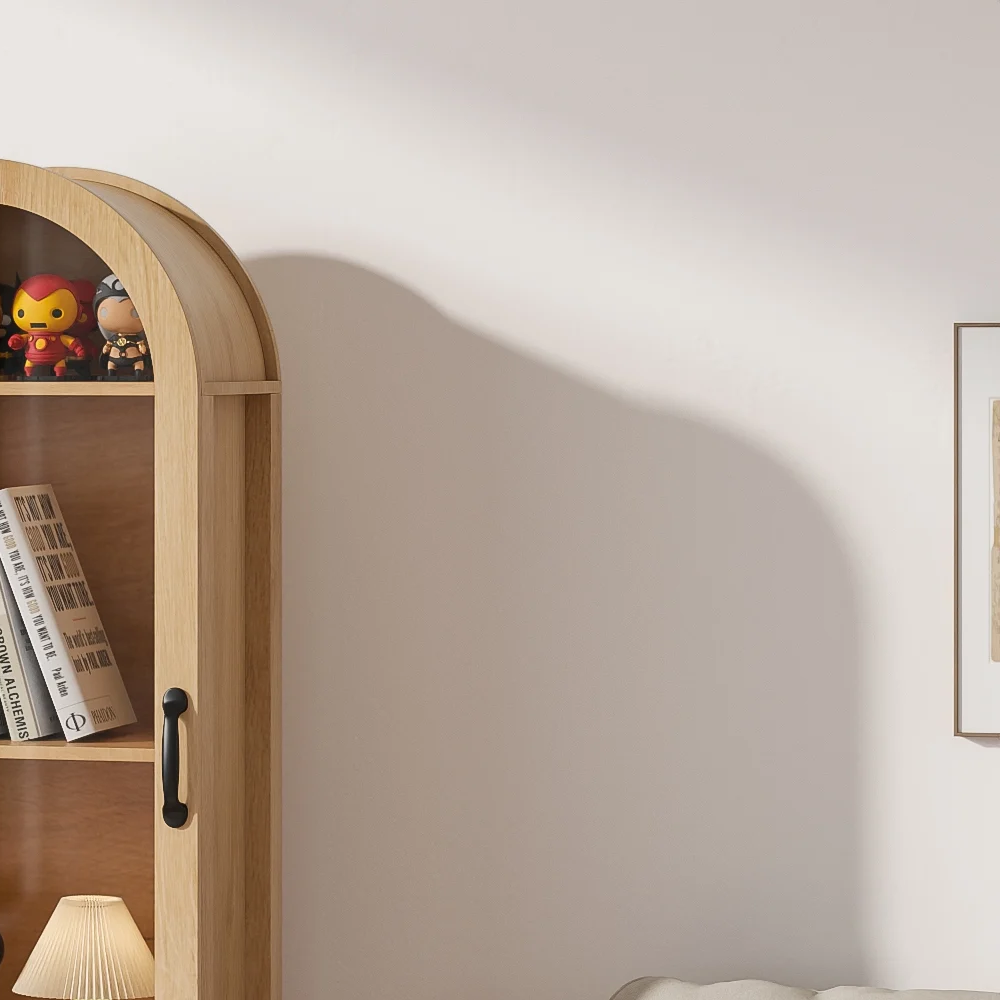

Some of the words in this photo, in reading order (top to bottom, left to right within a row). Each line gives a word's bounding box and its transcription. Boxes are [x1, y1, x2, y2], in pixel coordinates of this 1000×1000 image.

[9, 549, 21, 561] YOU
[18, 575, 30, 586] IT'S
[22, 586, 35, 599] HOW
[32, 614, 44, 627] YOU
[37, 626, 51, 642] WANT
[42, 642, 54, 651] TO
[52, 667, 64, 680] Paul
[56, 680, 68, 697] Arden
[4, 678, 30, 740] ALCHEMIS
